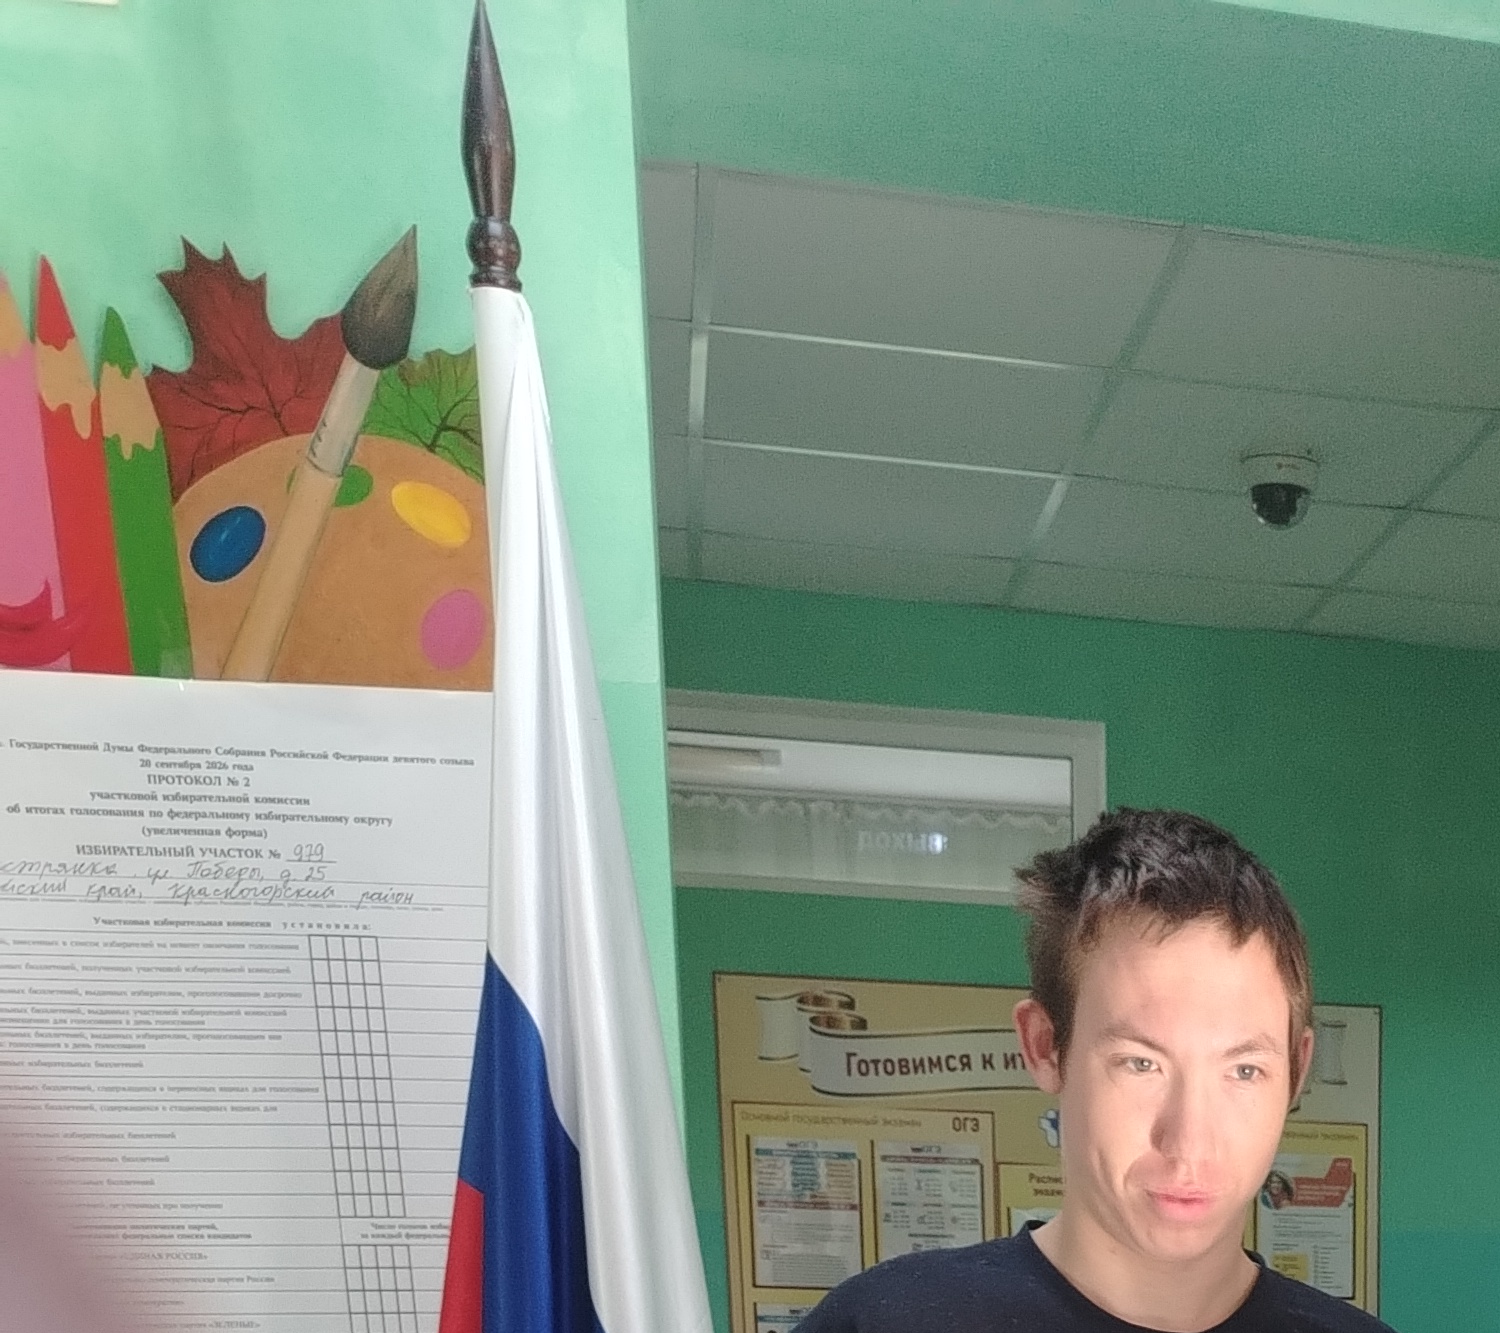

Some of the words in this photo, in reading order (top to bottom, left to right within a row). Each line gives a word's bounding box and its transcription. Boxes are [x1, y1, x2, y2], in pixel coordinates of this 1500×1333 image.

[9, 739, 99, 751] Государственной
[103, 742, 134, 753] Думы
[137, 743, 212, 756] Федерального
[215, 746, 266, 758] Собрания
[270, 749, 329, 760] Российской
[332, 751, 389, 763] Федерации
[139, 759, 151, 768] 20
[155, 759, 202, 771] сентября
[205, 761, 229, 770] 2026
[232, 763, 254, 771] года
[147, 774, 222, 787] ПРОТОКОЛ
[226, 777, 239, 787] №
[243, 777, 251, 787] 2
[90, 790, 158, 802] участковой
[162, 792, 250, 804] избирательной
[254, 796, 311, 806] комиссии
[6, 803, 21, 814] об
[25, 805, 65, 815] итогах
[70, 807, 144, 818] голосования
[149, 809, 163, 818] по
[167, 809, 250, 821] федеральному
[254, 811, 350, 825] избирательному
[353, 815, 393, 827] округу
[141, 826, 221, 838] (увеличенная
[225, 828, 268, 840] форма)
[76, 844, 195, 858] ИЗБИРАТЕЛЬНЫЙ
[199, 847, 264, 860] УЧАСТОК
[268, 849, 281, 860] №
[304, 865, 328, 882] 25
[846, 1052, 972, 1077] Готовимся
[982, 1052, 996, 1070] к
